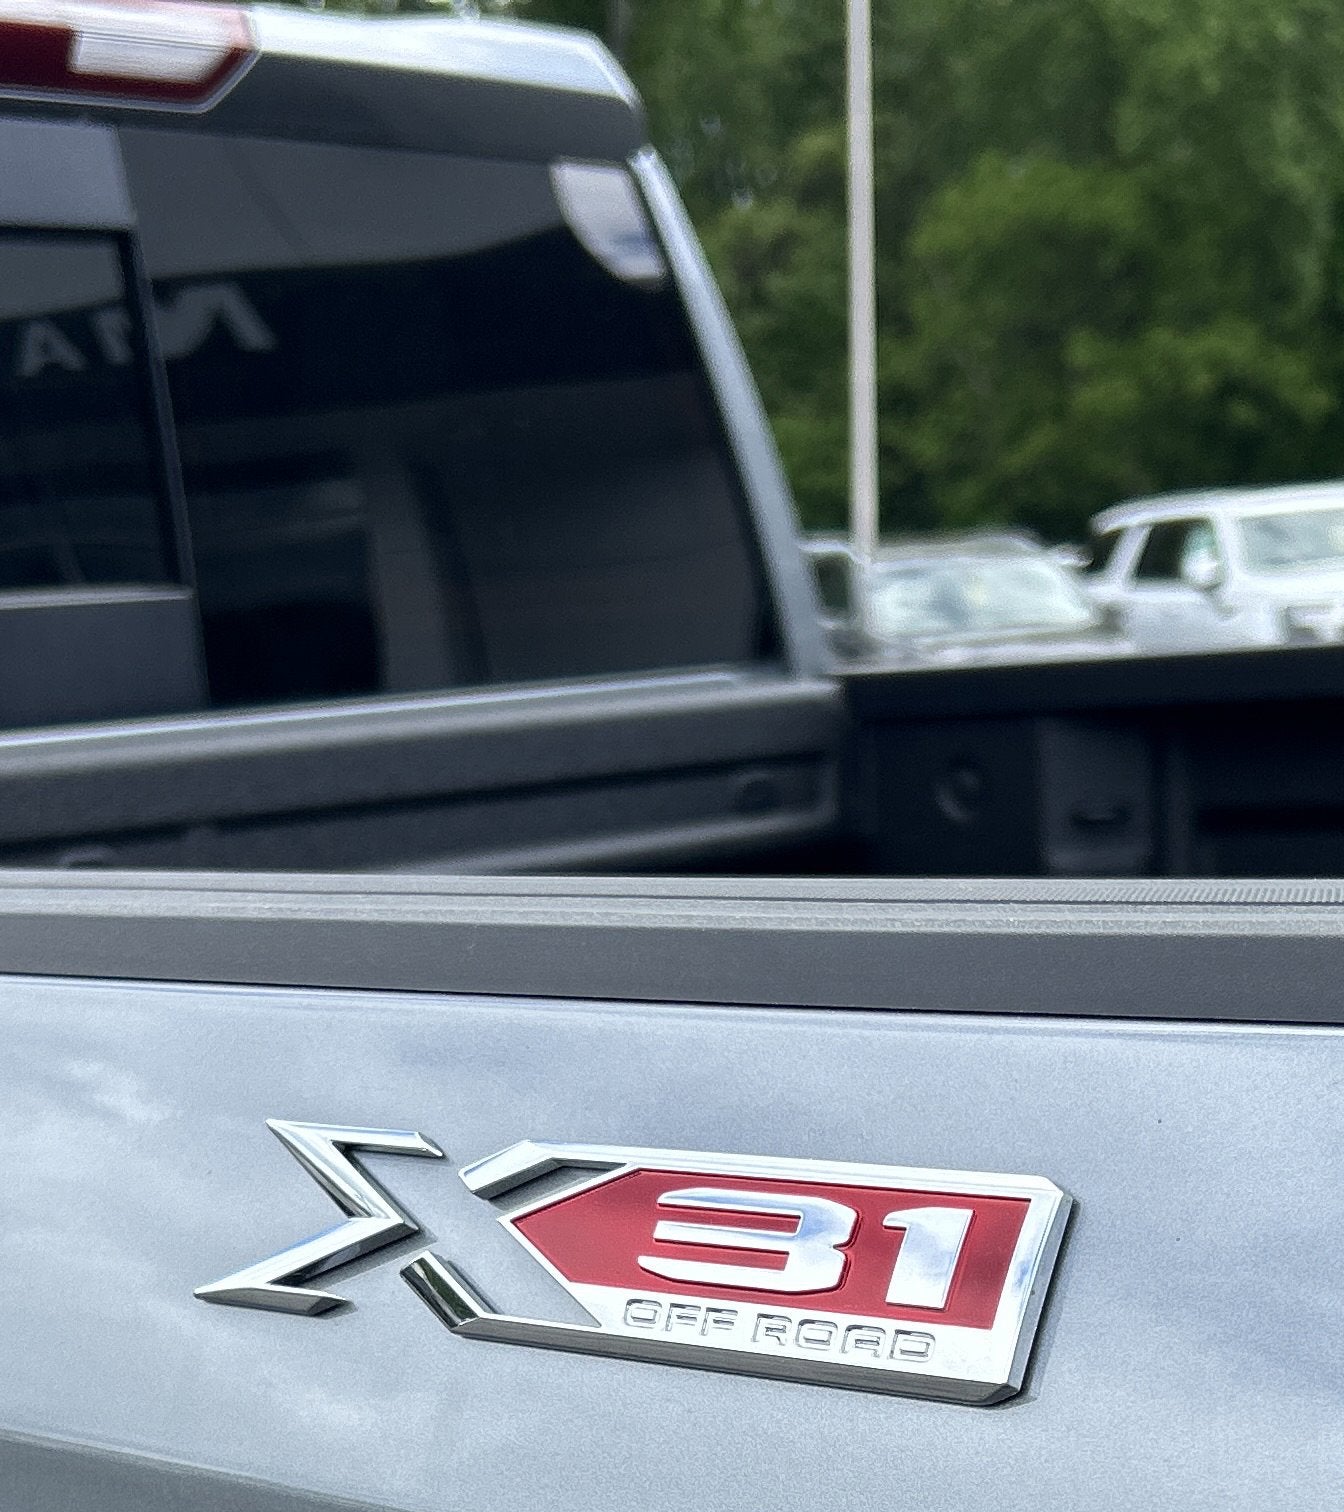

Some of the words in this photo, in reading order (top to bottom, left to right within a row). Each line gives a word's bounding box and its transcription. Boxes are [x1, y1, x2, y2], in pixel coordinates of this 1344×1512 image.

[194, 1118, 976, 1334] X31
[623, 1298, 739, 1336] OFF
[752, 1312, 937, 1363] ROAD
